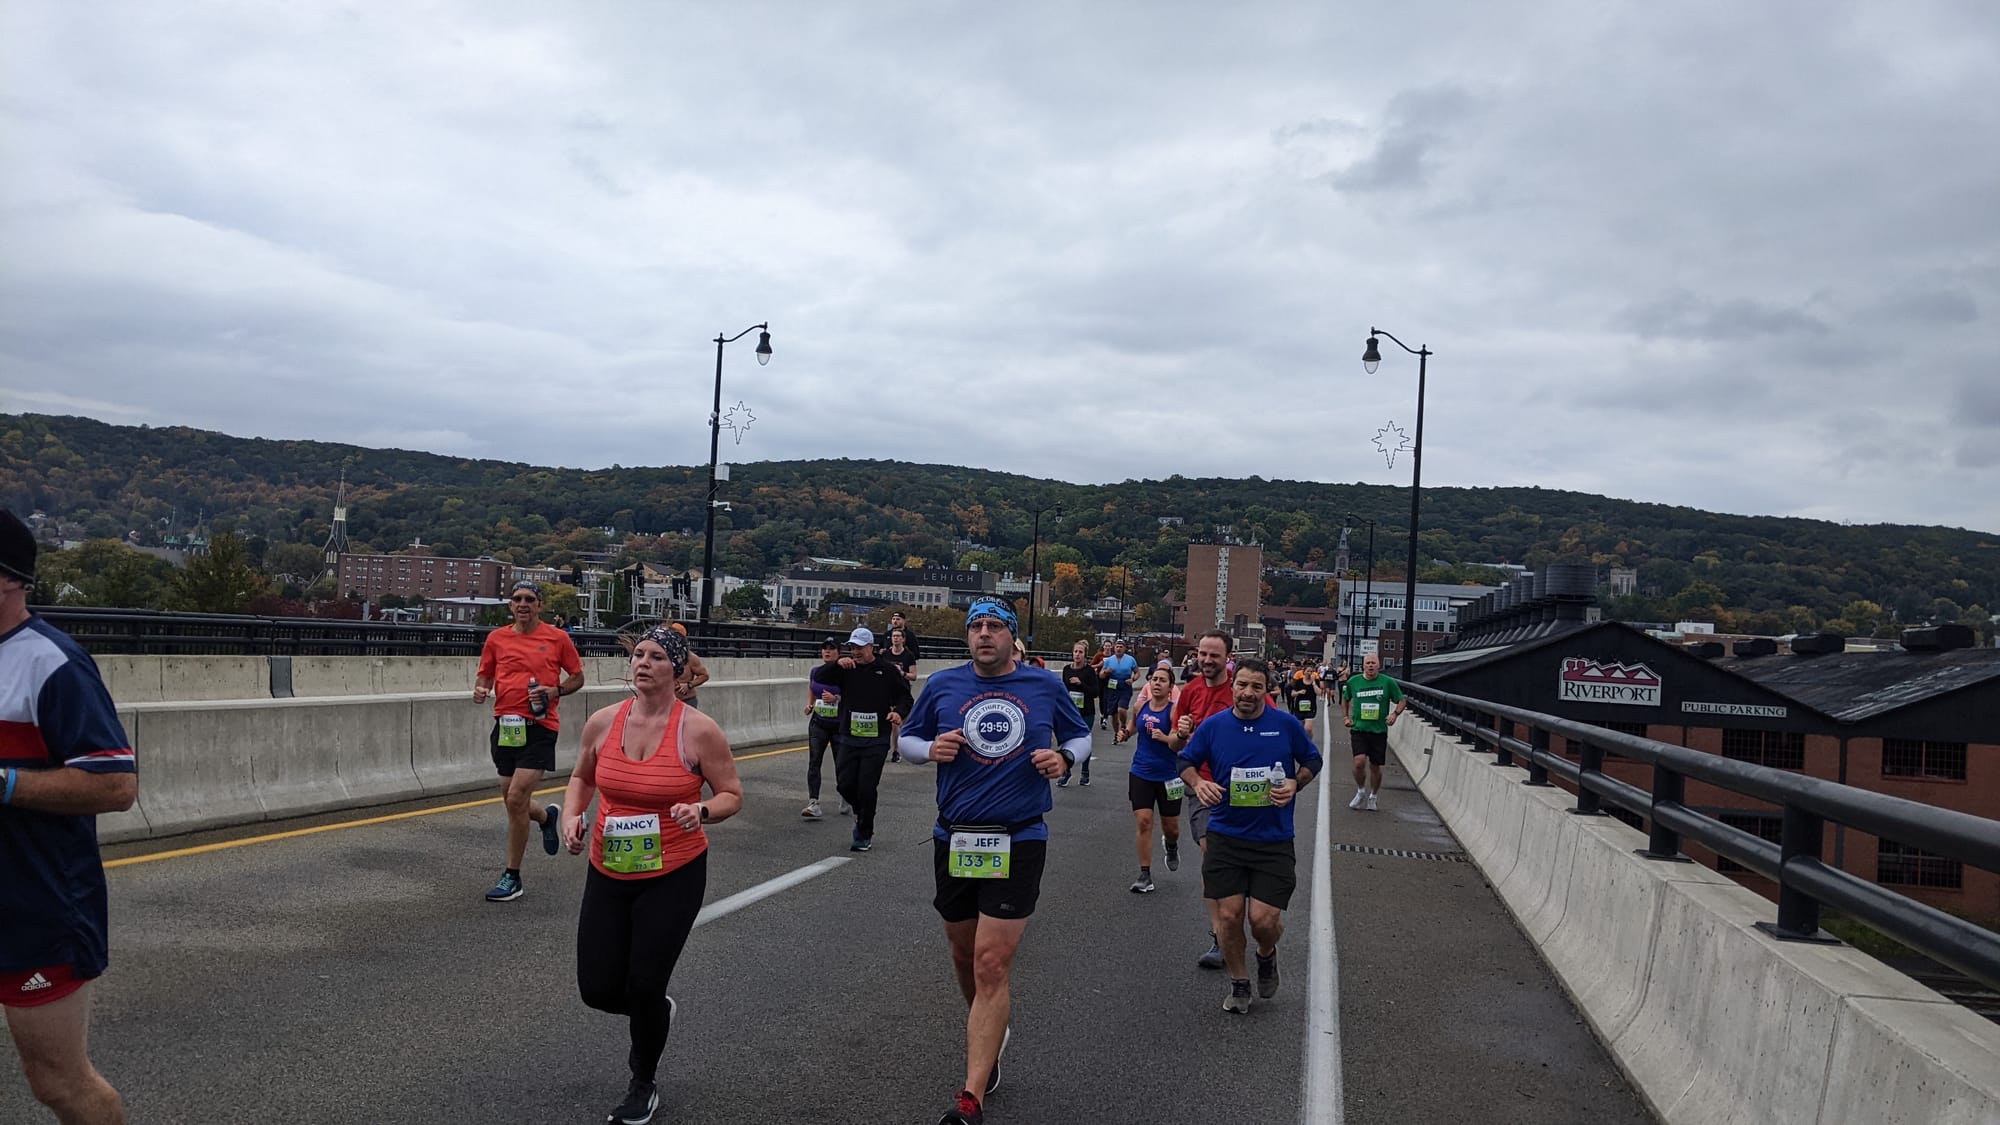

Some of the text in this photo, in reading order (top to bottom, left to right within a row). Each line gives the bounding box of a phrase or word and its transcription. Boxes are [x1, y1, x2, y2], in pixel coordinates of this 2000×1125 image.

[923, 572, 974, 582] LEHIGH
[982, 704, 1004, 713] THIRTY
[1005, 707, 1019, 723] CLUB
[1684, 702, 1785, 716] PUBLIC PARKING
[514, 727, 521, 735] B
[980, 721, 1009, 733] 29:59
[1245, 770, 1265, 779] ERIC
[1235, 783, 1267, 793] 3407
[616, 819, 654, 831] NANCY
[607, 837, 654, 852] 273 B
[974, 837, 1000, 847] JEFF
[957, 854, 1002, 868] 133 B
[21, 981, 52, 991] adidas
